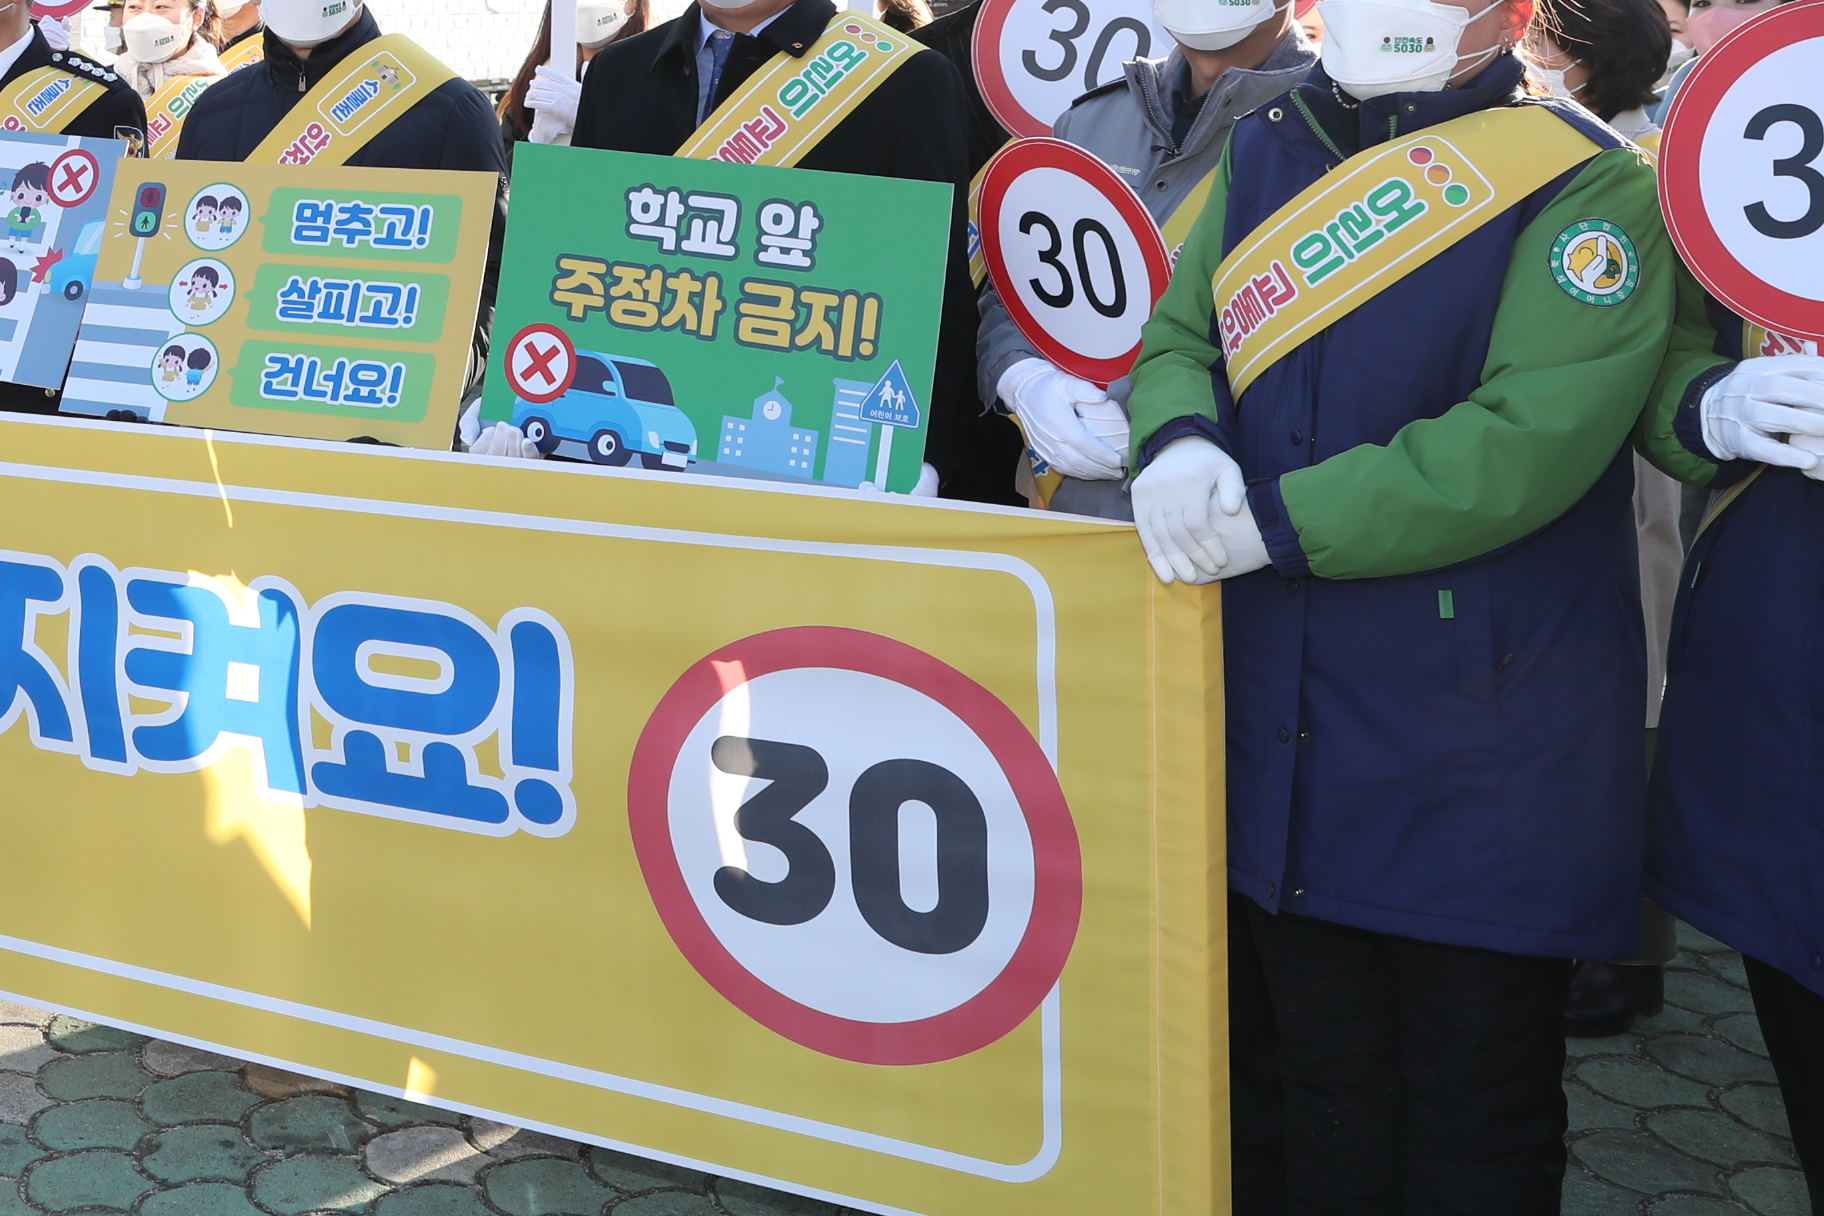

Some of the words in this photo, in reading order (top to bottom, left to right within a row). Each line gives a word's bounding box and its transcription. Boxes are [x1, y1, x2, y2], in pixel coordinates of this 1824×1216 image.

[778, 41, 870, 120] 어린이
[1394, 44, 1423, 53] 5030
[330, 78, 382, 123] 스쿨존
[1743, 103, 1824, 239] 3
[292, 200, 432, 248] 멈추고!
[626, 186, 740, 259] 학교
[756, 200, 821, 269] 앞
[1292, 178, 1427, 287] 어린이
[278, 277, 419, 327] 살피고!
[1018, 210, 1127, 318] 30
[551, 256, 725, 339] 주정차
[736, 279, 881, 359] 금지!
[262, 354, 404, 406] 건너요!
[869, 409, 892, 421] 어린이
[894, 412, 909, 422] 보호
[710, 734, 990, 956] 30
